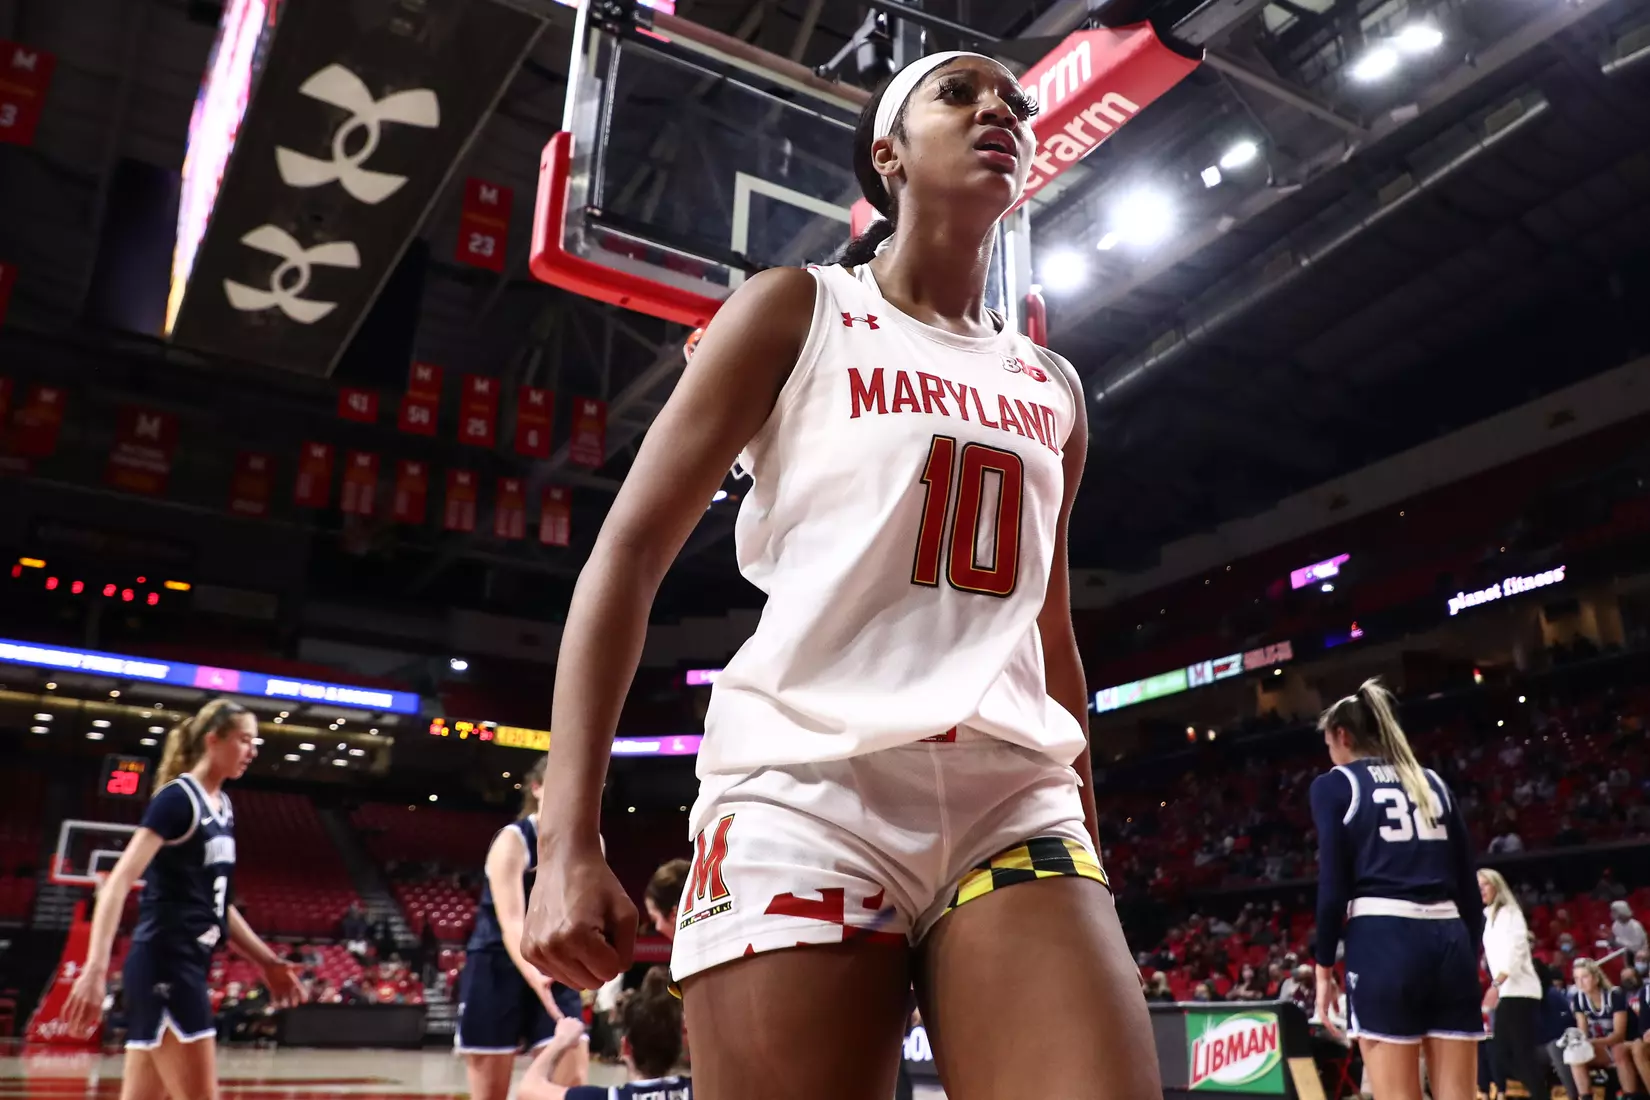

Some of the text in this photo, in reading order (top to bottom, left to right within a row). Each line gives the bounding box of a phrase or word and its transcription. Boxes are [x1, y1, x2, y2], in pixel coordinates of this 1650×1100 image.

[468, 231, 495, 258] 23
[847, 367, 1060, 456] MARYLAND
[910, 434, 1025, 598] 10
[1448, 567, 1565, 615] planet fitness
[1367, 765, 1401, 784] RUN
[1372, 788, 1448, 842] 32
[682, 813, 735, 916] M
[1191, 1021, 1278, 1084] LIBMAN
